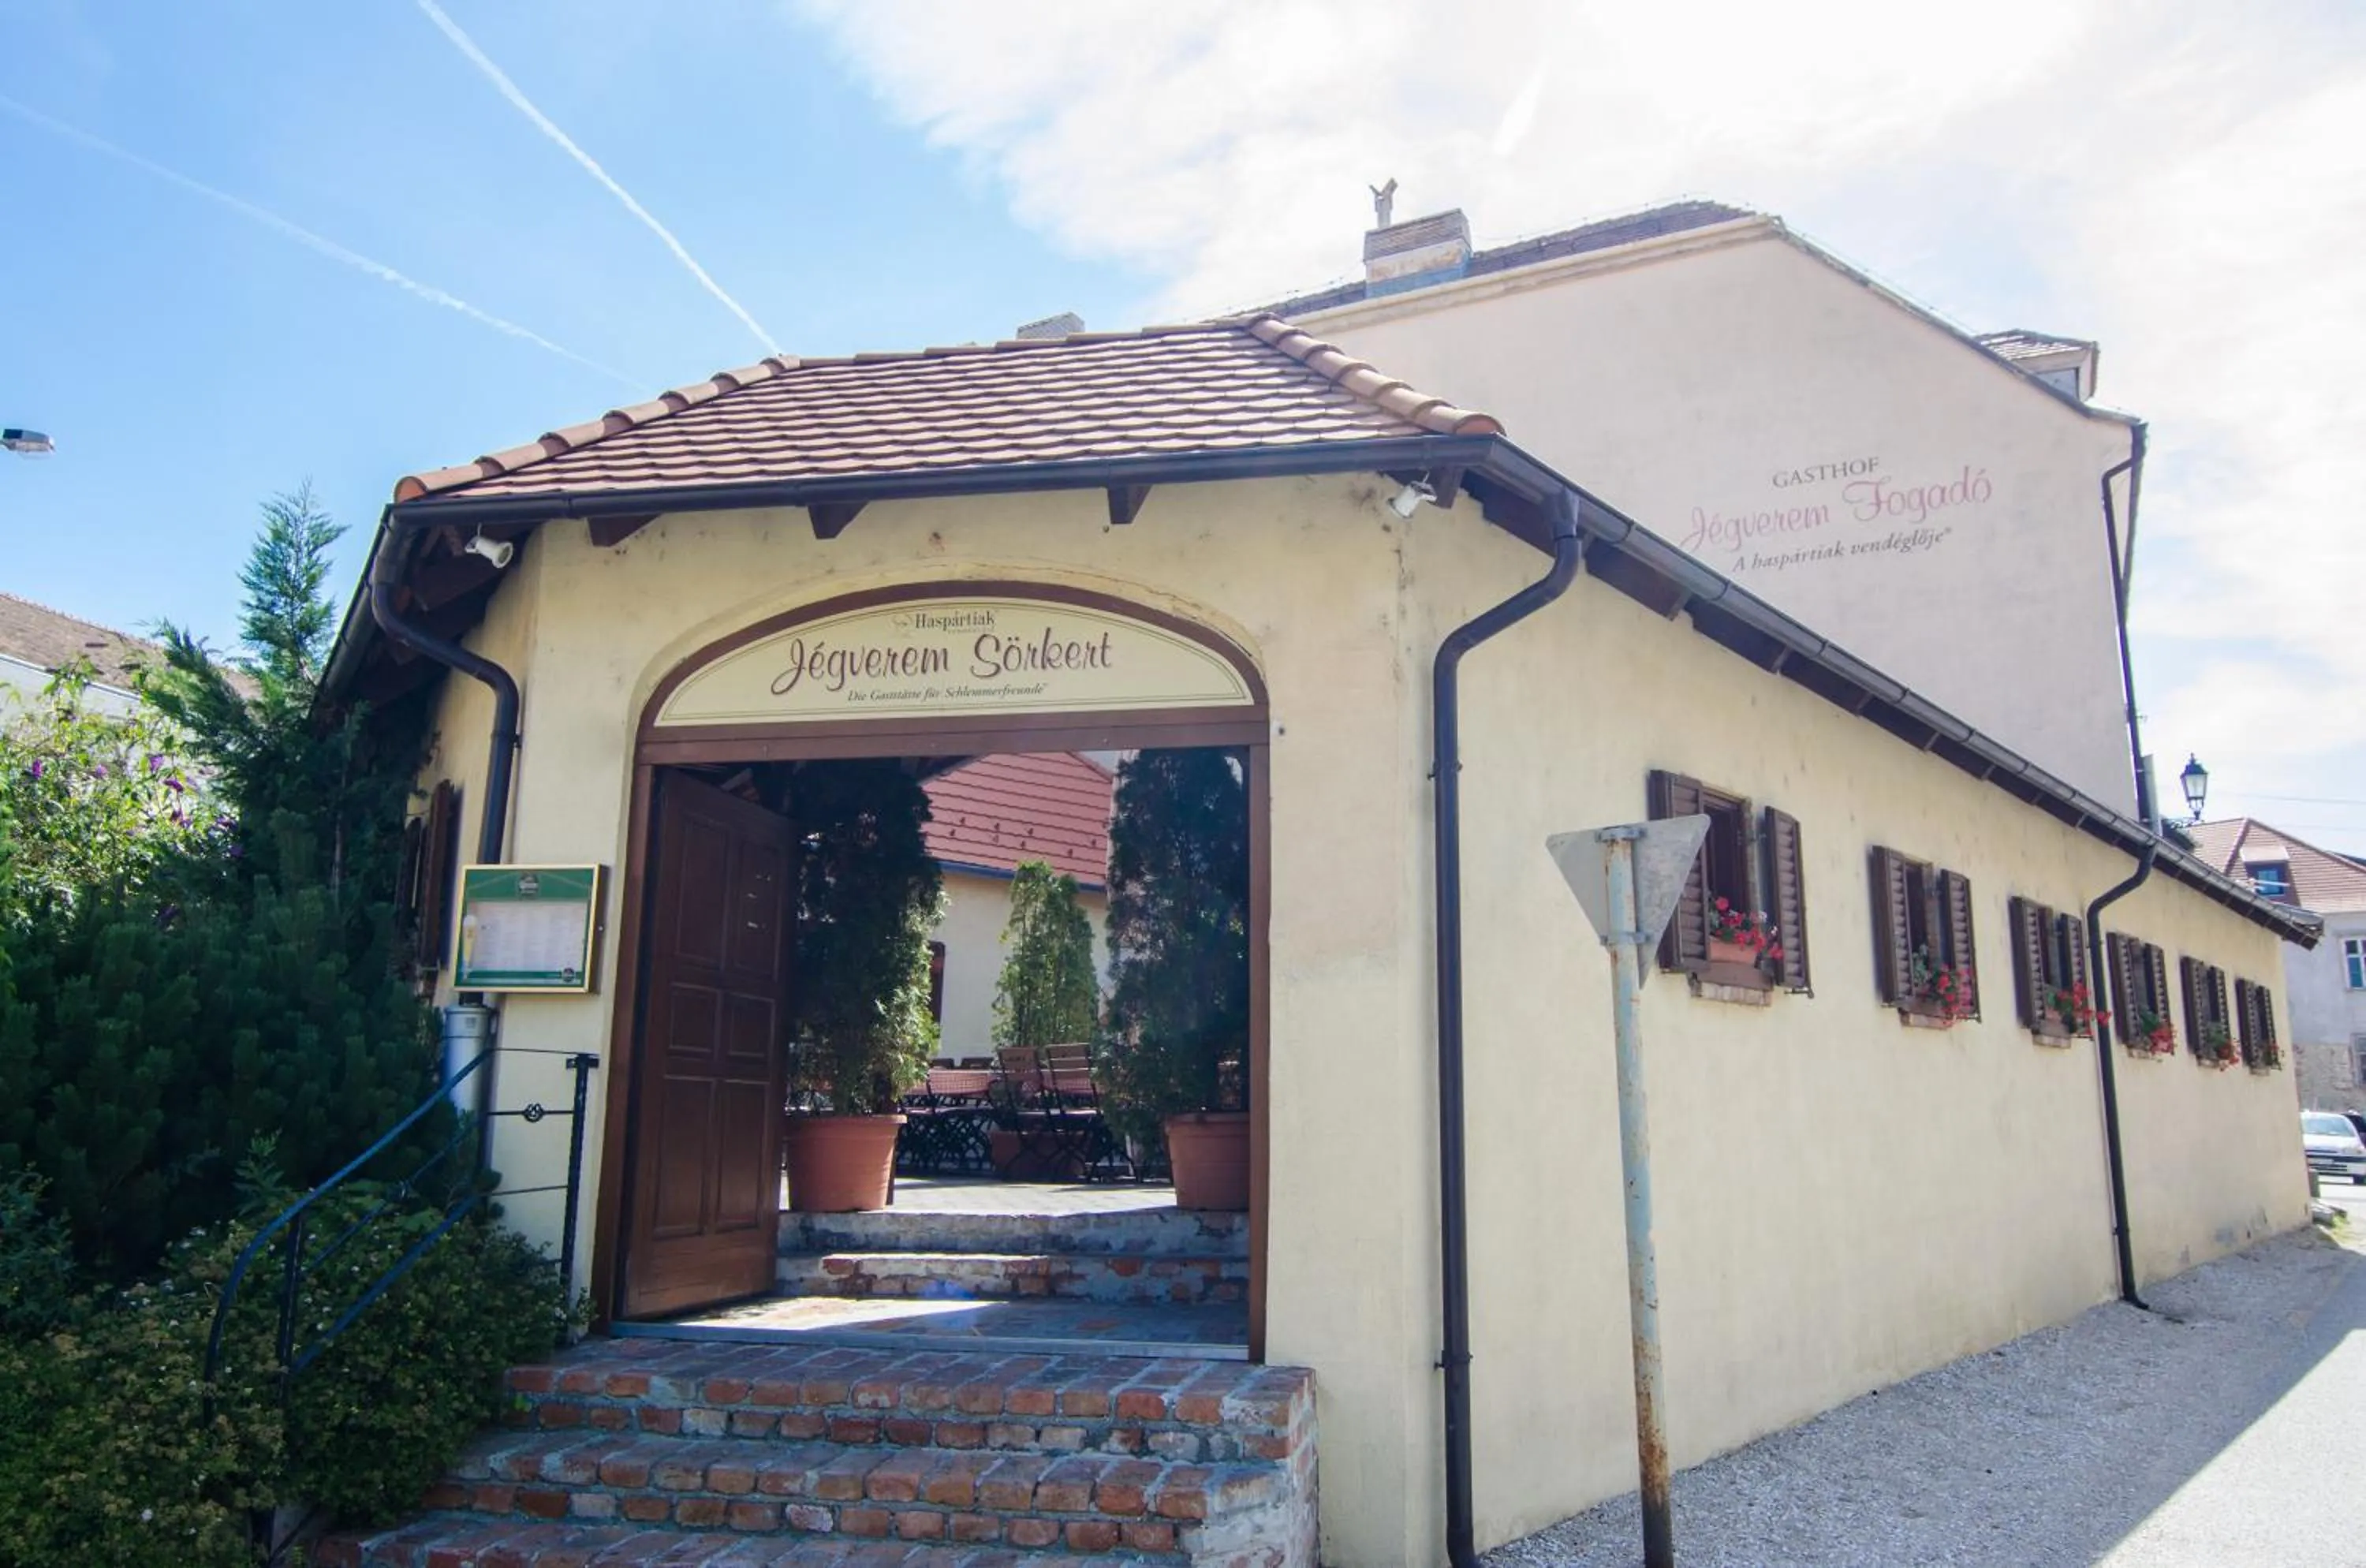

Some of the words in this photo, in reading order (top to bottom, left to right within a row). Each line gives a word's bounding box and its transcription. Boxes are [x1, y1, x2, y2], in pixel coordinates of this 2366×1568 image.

[1772, 457, 1879, 488] GASTHOF
[1678, 505, 1830, 554] Jégverem
[1842, 465, 1993, 525] Fogadó
[1732, 555, 1746, 573] A
[914, 610, 996, 631] Haspártiak
[770, 637, 950, 696] Jégverem
[970, 627, 1113, 679] Sörkert
[847, 689, 868, 702] Die
[924, 687, 941, 701] für
